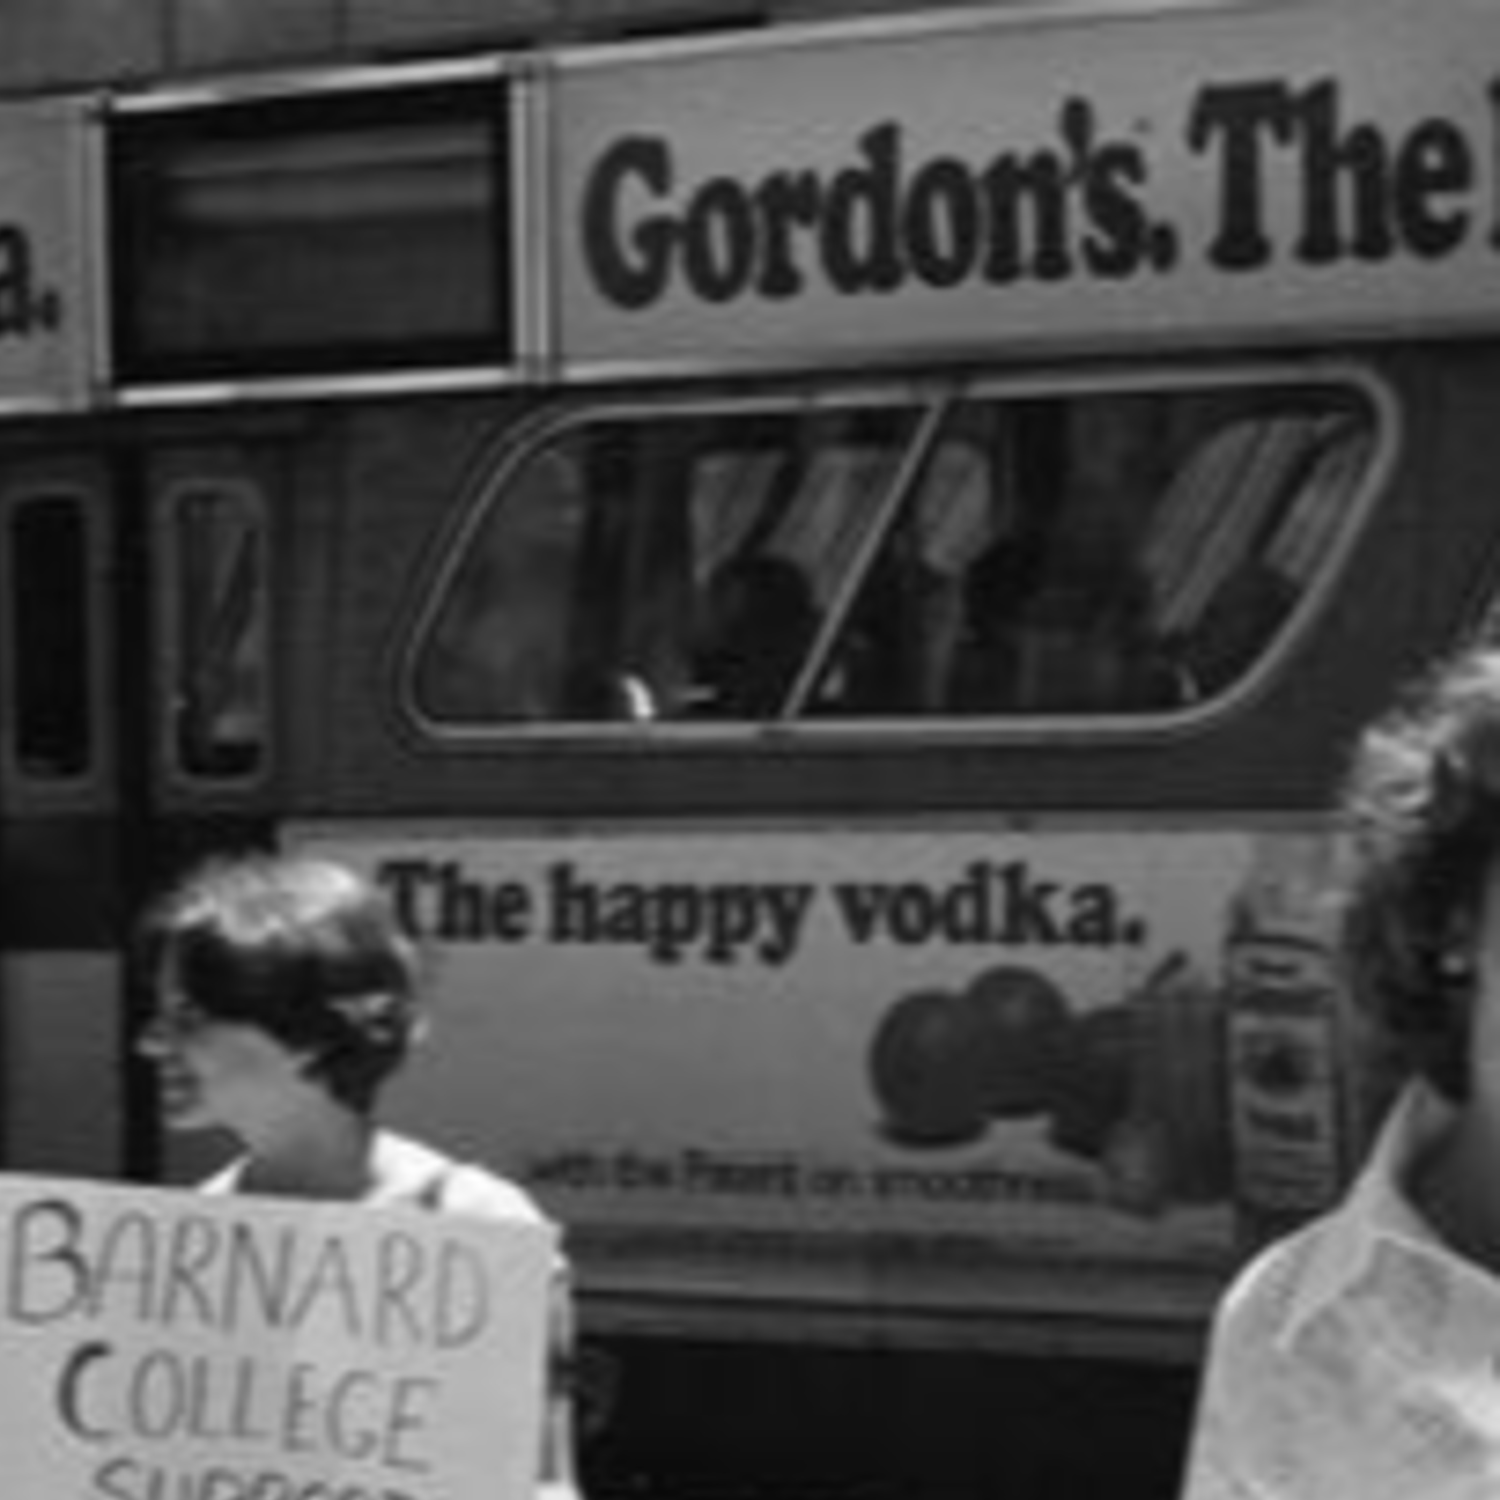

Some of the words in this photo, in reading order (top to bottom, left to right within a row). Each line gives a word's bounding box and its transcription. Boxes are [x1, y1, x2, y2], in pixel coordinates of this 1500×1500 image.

[581, 96, 1178, 310] Gordon's.
[1186, 77, 1475, 272] The
[377, 861, 532, 944] The
[547, 862, 816, 965] happy
[836, 861, 1148, 947] vodka.
[6, 1197, 492, 1351] BARNARD
[55, 1339, 442, 1475] COLLEGE
